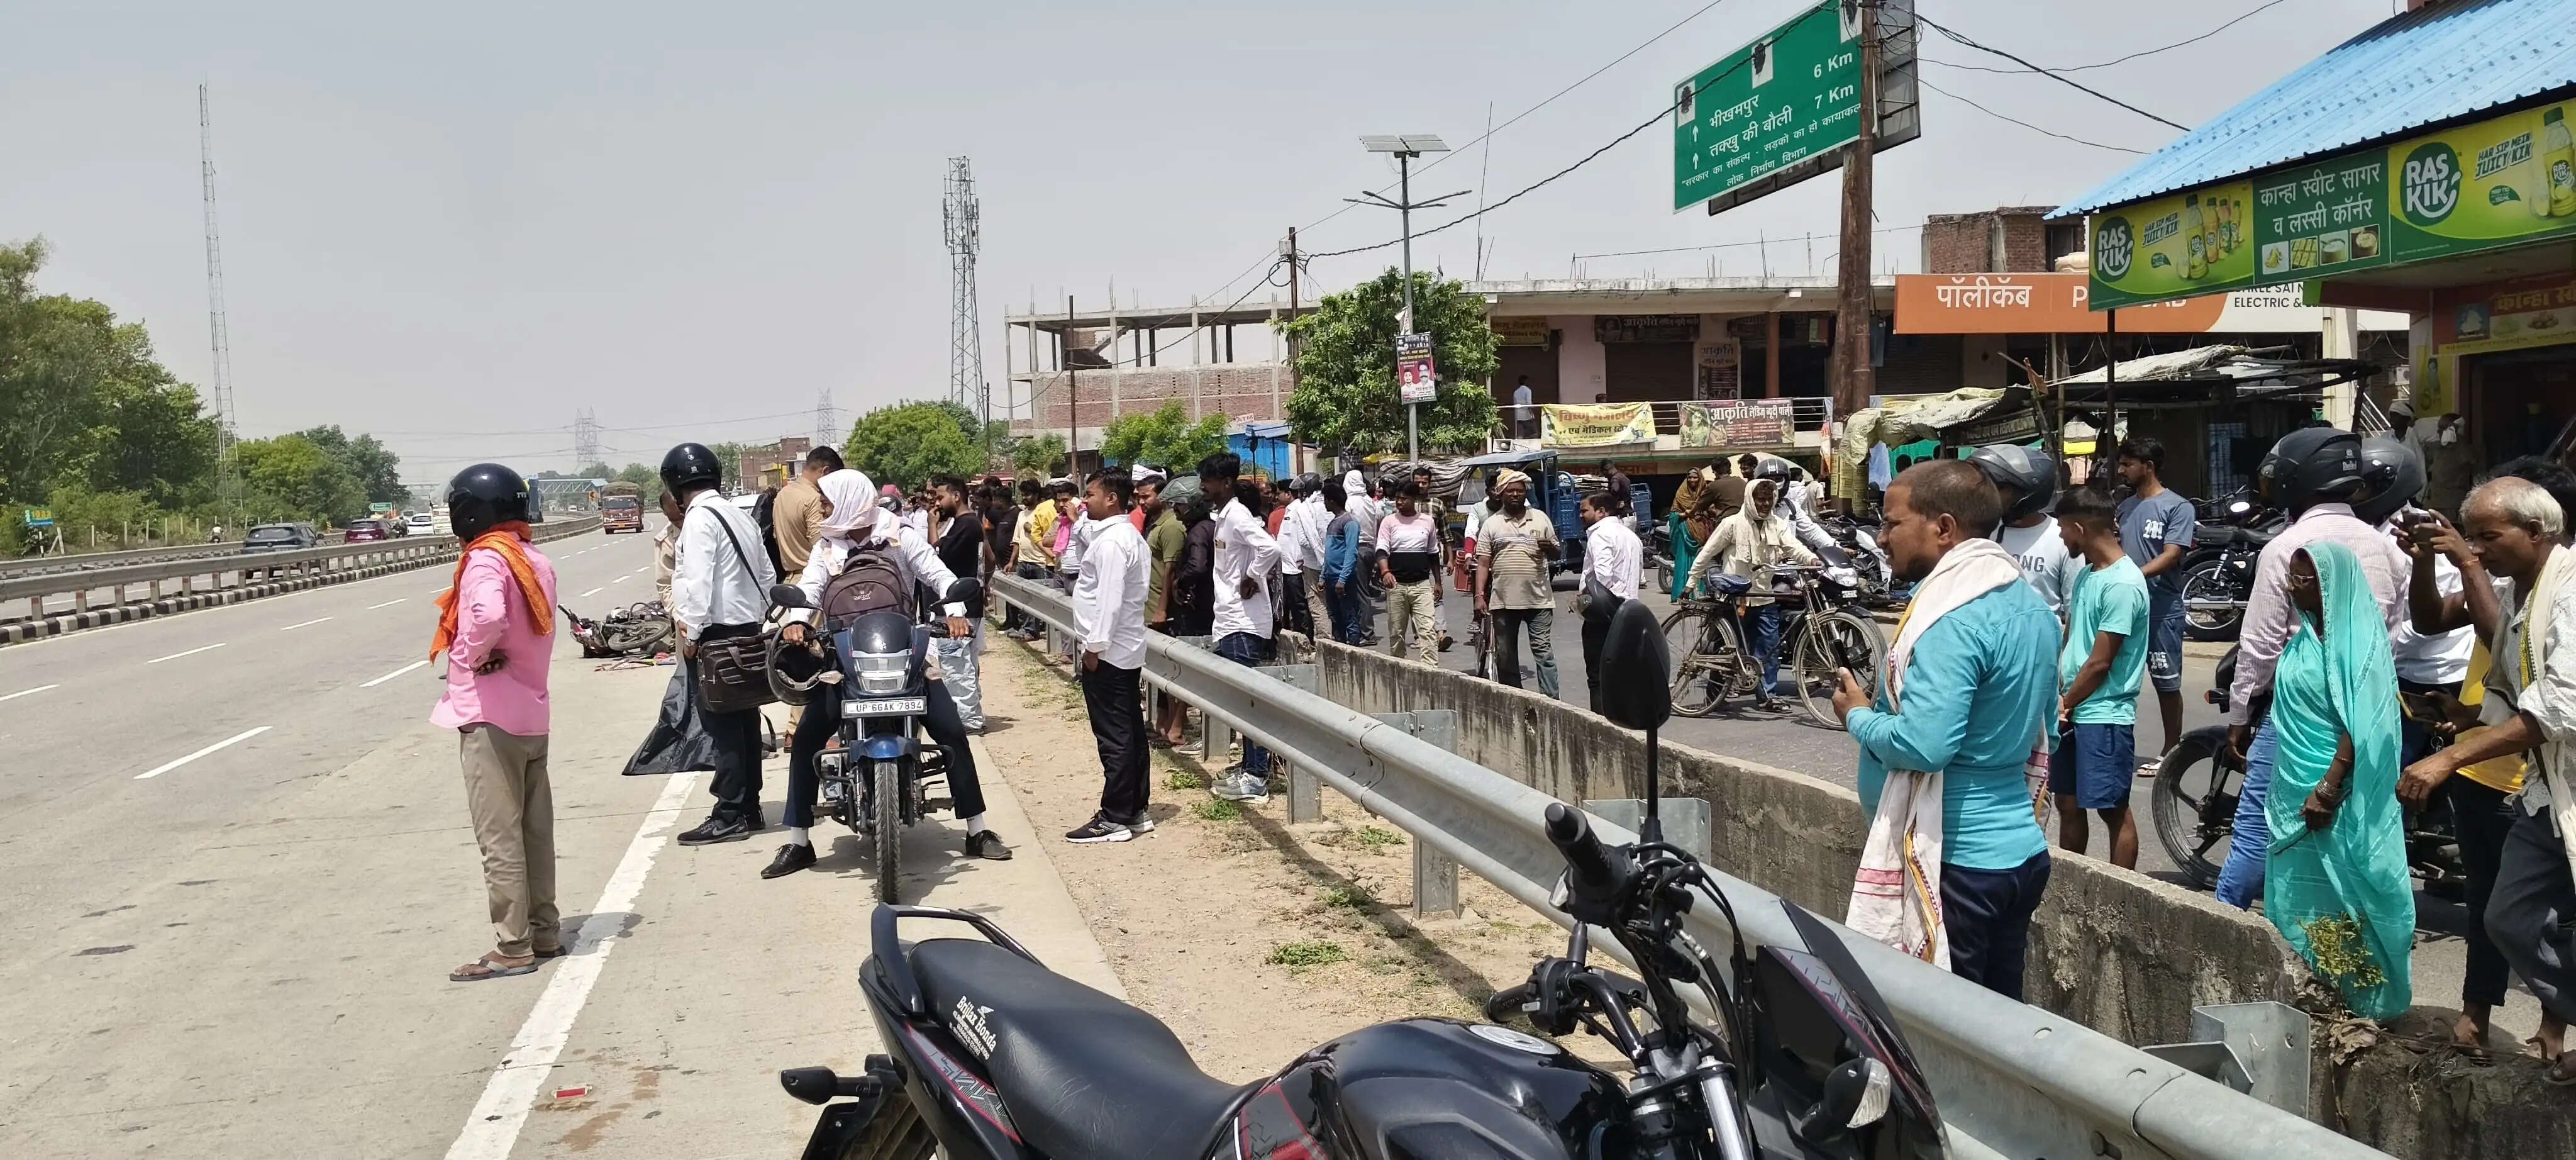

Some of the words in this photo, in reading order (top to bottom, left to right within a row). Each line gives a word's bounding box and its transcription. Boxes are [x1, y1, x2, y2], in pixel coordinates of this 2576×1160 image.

[1814, 64, 1821, 78] 6
[1828, 52, 1852, 72] Km
[1709, 94, 1760, 128] भीखमपुर
[1814, 94, 1822, 109] 7
[1829, 84, 1853, 103] Km
[1742, 121, 1759, 142] की
[1762, 105, 1793, 131] बौली
[1713, 165, 1723, 175] का
[1726, 152, 1751, 169] संकल्प
[1793, 128, 1805, 138] का
[1809, 120, 1818, 133] हो
[2475, 152, 2509, 177] JUICY
[2510, 142, 2532, 164] KIK
[1727, 174, 1744, 187] लोक
[1751, 160, 1775, 177] निर्माण
[1782, 146, 1806, 164] विभाग
[2406, 153, 2450, 187] RAS
[2260, 182, 2297, 207] कान्हा
[2301, 169, 2336, 197] स्वीट
[2340, 163, 2380, 189] सागर
[2407, 179, 2458, 217] KIK
[2273, 218, 2284, 235] व
[2287, 201, 2327, 233] लस्सी
[2331, 192, 2373, 224] कॉर्नर
[2098, 225, 2126, 250] RAS
[2098, 245, 2131, 275] KIK
[2235, 297, 2290, 308] ELECTRIC
[2293, 298, 2302, 308] &
[1710, 401, 1748, 425] आकृति
[856, 703, 867, 712] UP
[957, 995, 978, 1026] Brijlax
[974, 1017, 996, 1052] Honda
